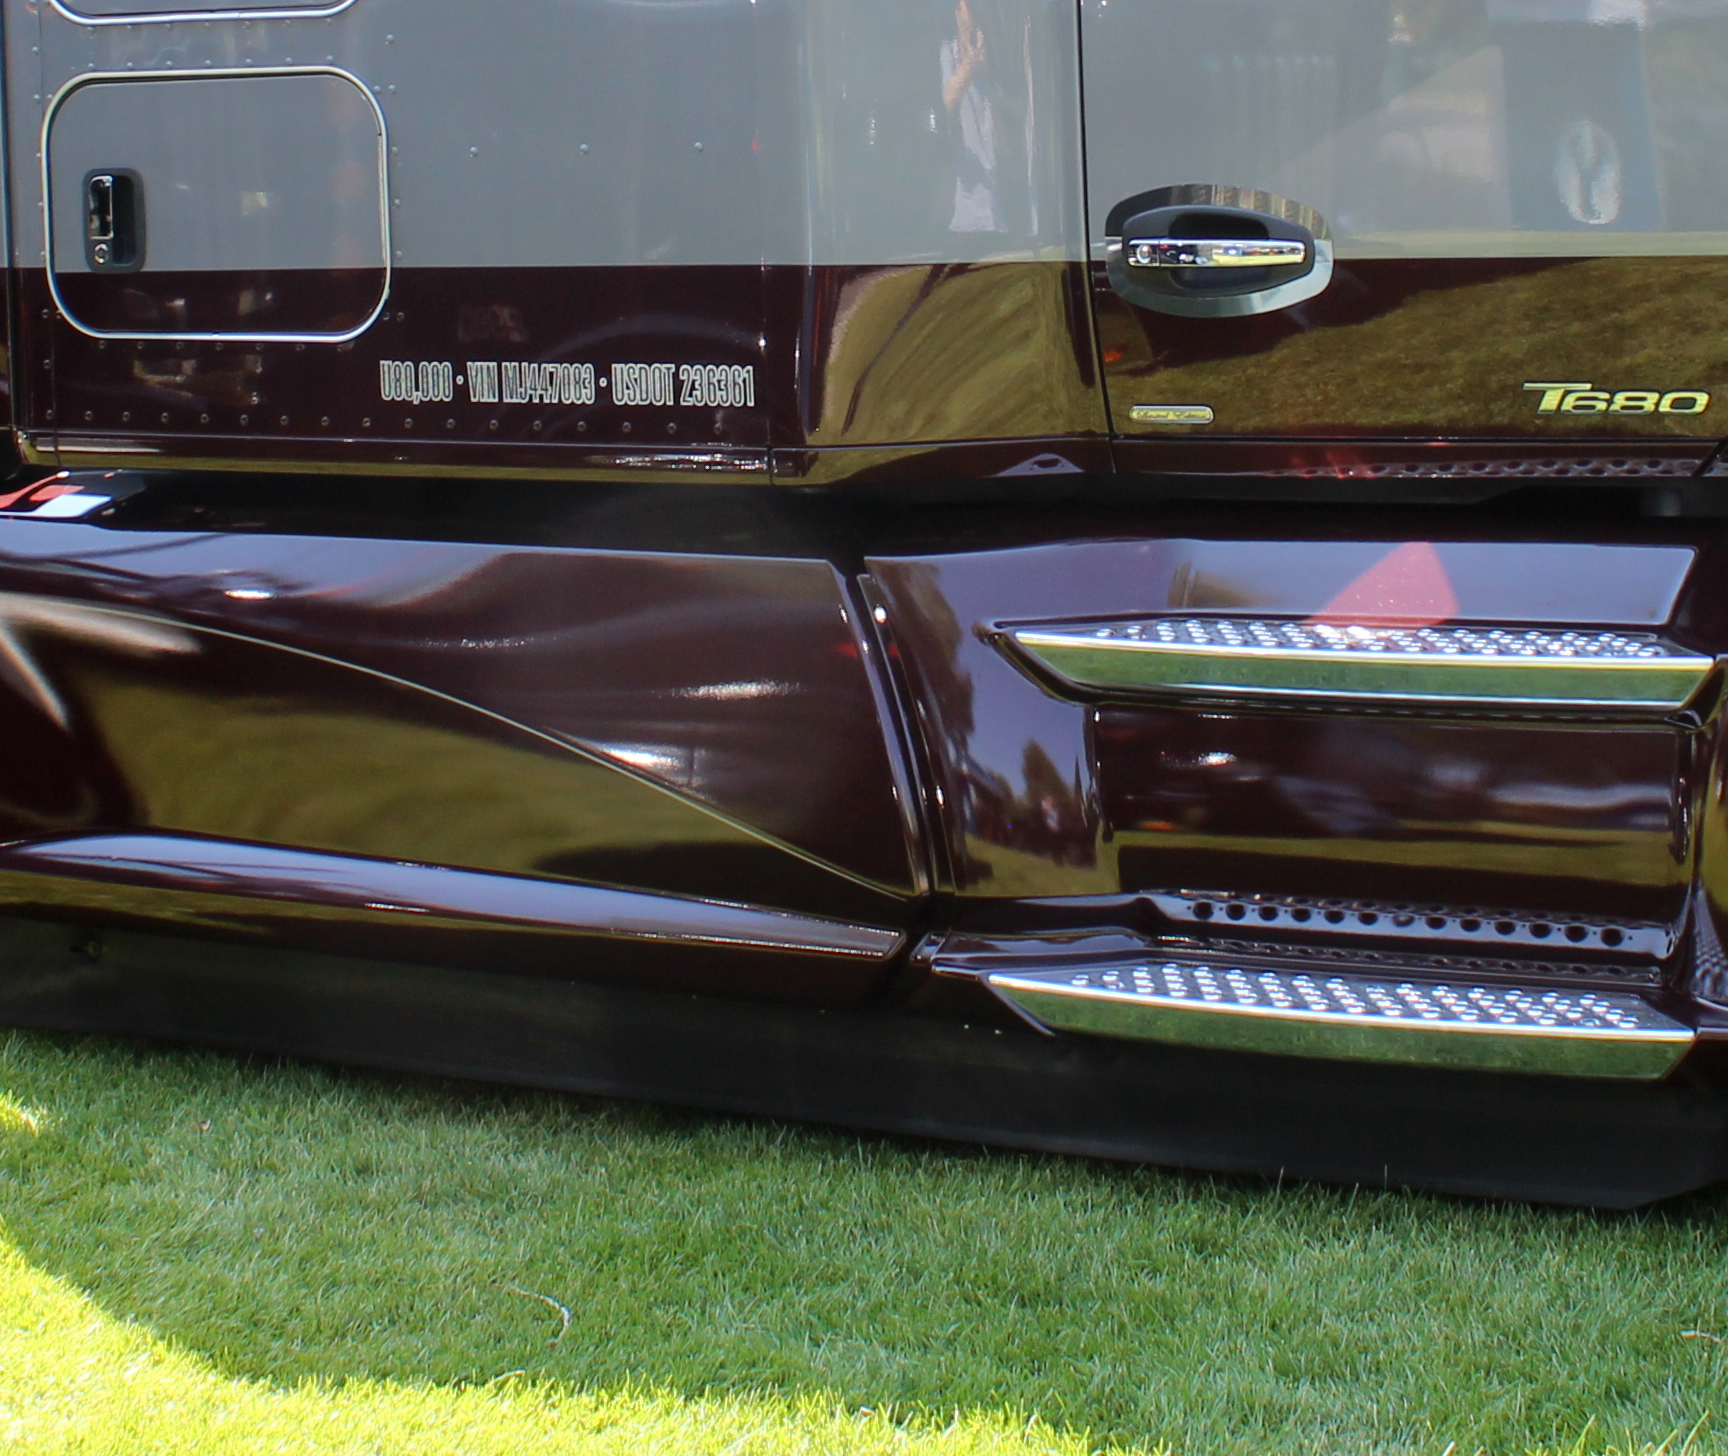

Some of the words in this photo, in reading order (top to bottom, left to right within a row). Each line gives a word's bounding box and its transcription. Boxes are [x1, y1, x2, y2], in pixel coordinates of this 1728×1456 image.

[466, 361, 499, 403] VIN
[501, 362, 596, 405] MJ447083
[611, 363, 676, 406] USDOT
[679, 364, 755, 407] 236361
[1522, 382, 1712, 415] T680
